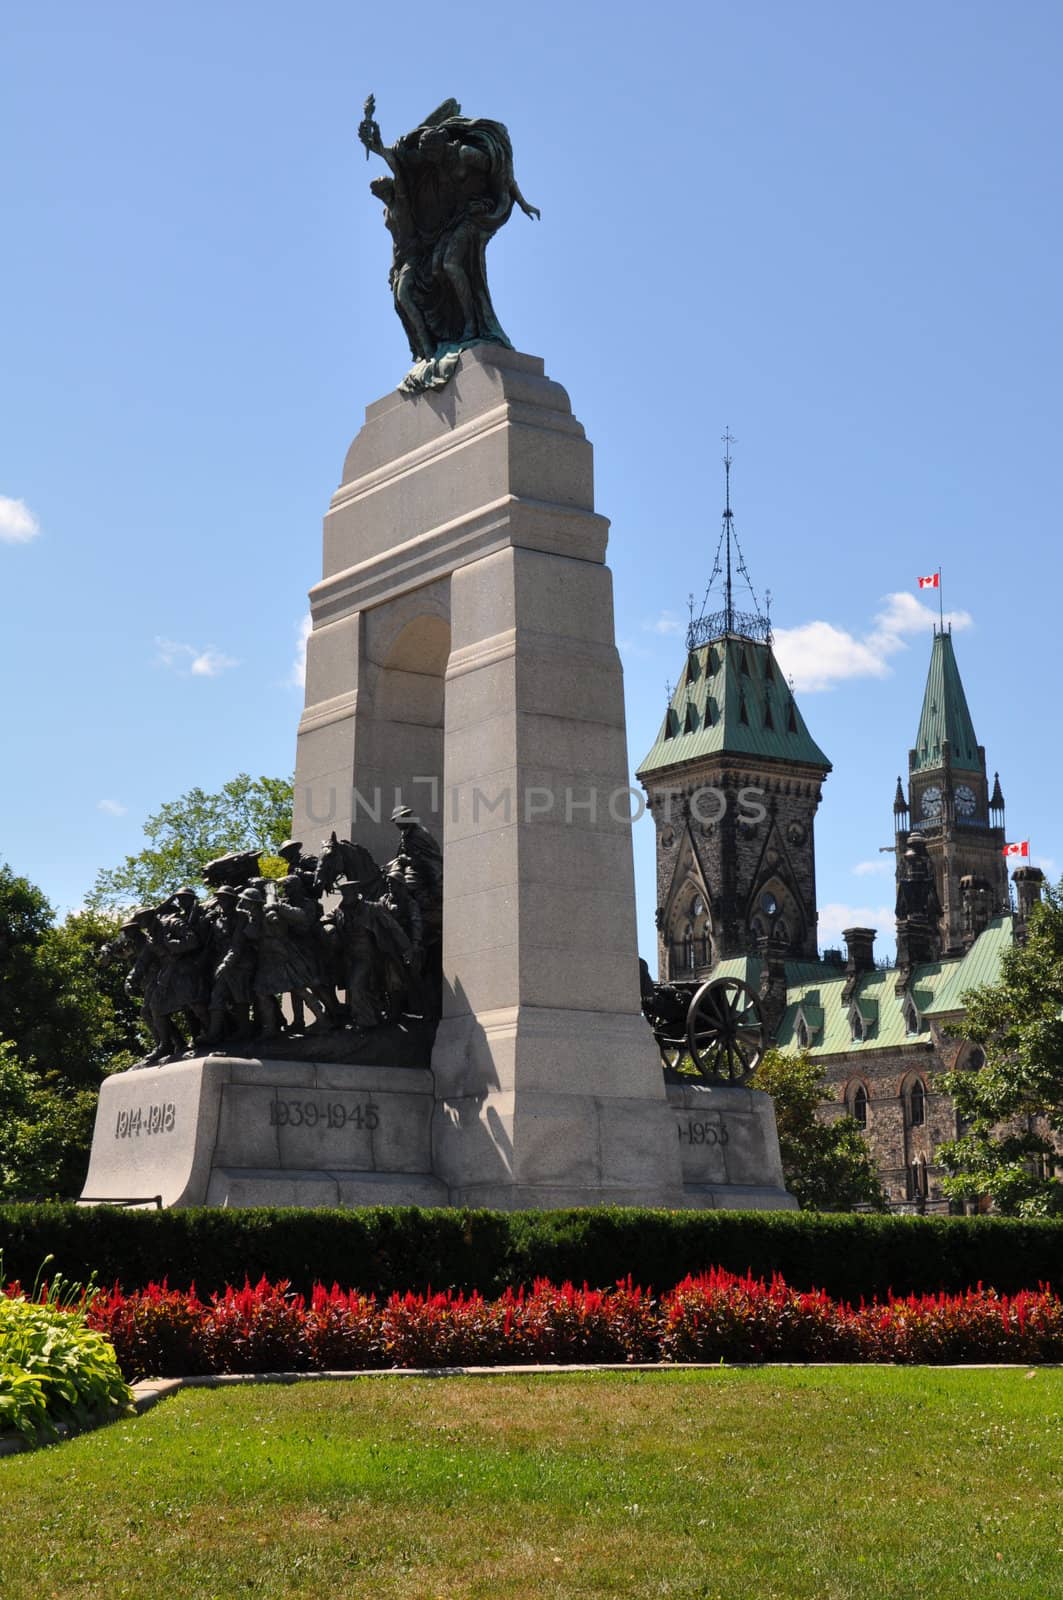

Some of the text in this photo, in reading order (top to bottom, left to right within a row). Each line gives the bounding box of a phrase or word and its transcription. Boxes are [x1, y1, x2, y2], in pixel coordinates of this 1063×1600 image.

[115, 1103, 176, 1139] 1914-1918
[269, 1101, 380, 1130] 1939-1945
[677, 1121, 729, 1146] -1953
